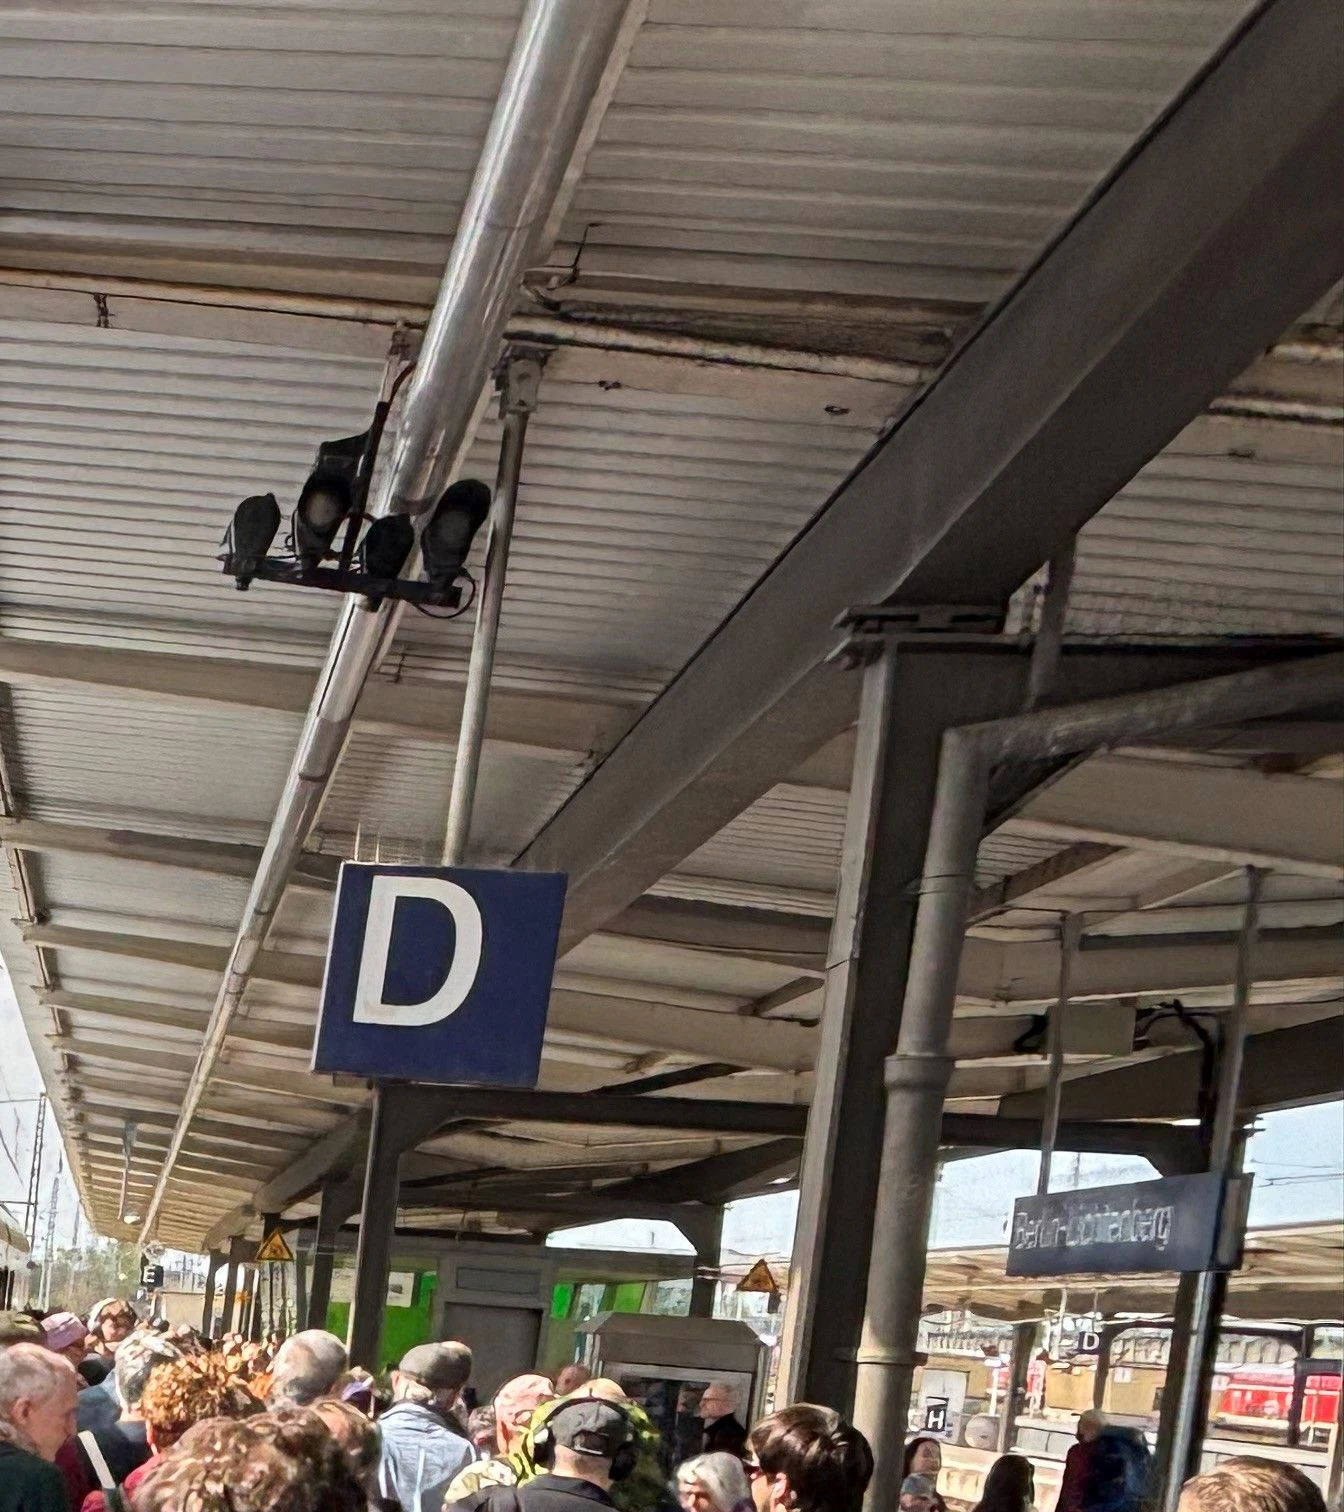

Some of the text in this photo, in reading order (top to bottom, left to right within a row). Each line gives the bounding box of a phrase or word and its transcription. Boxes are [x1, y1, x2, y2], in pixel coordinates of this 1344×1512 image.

[352, 874, 483, 1027] D
[143, 1265, 155, 1283] E
[1081, 1332, 1101, 1351] D
[928, 1409, 945, 1430] H
